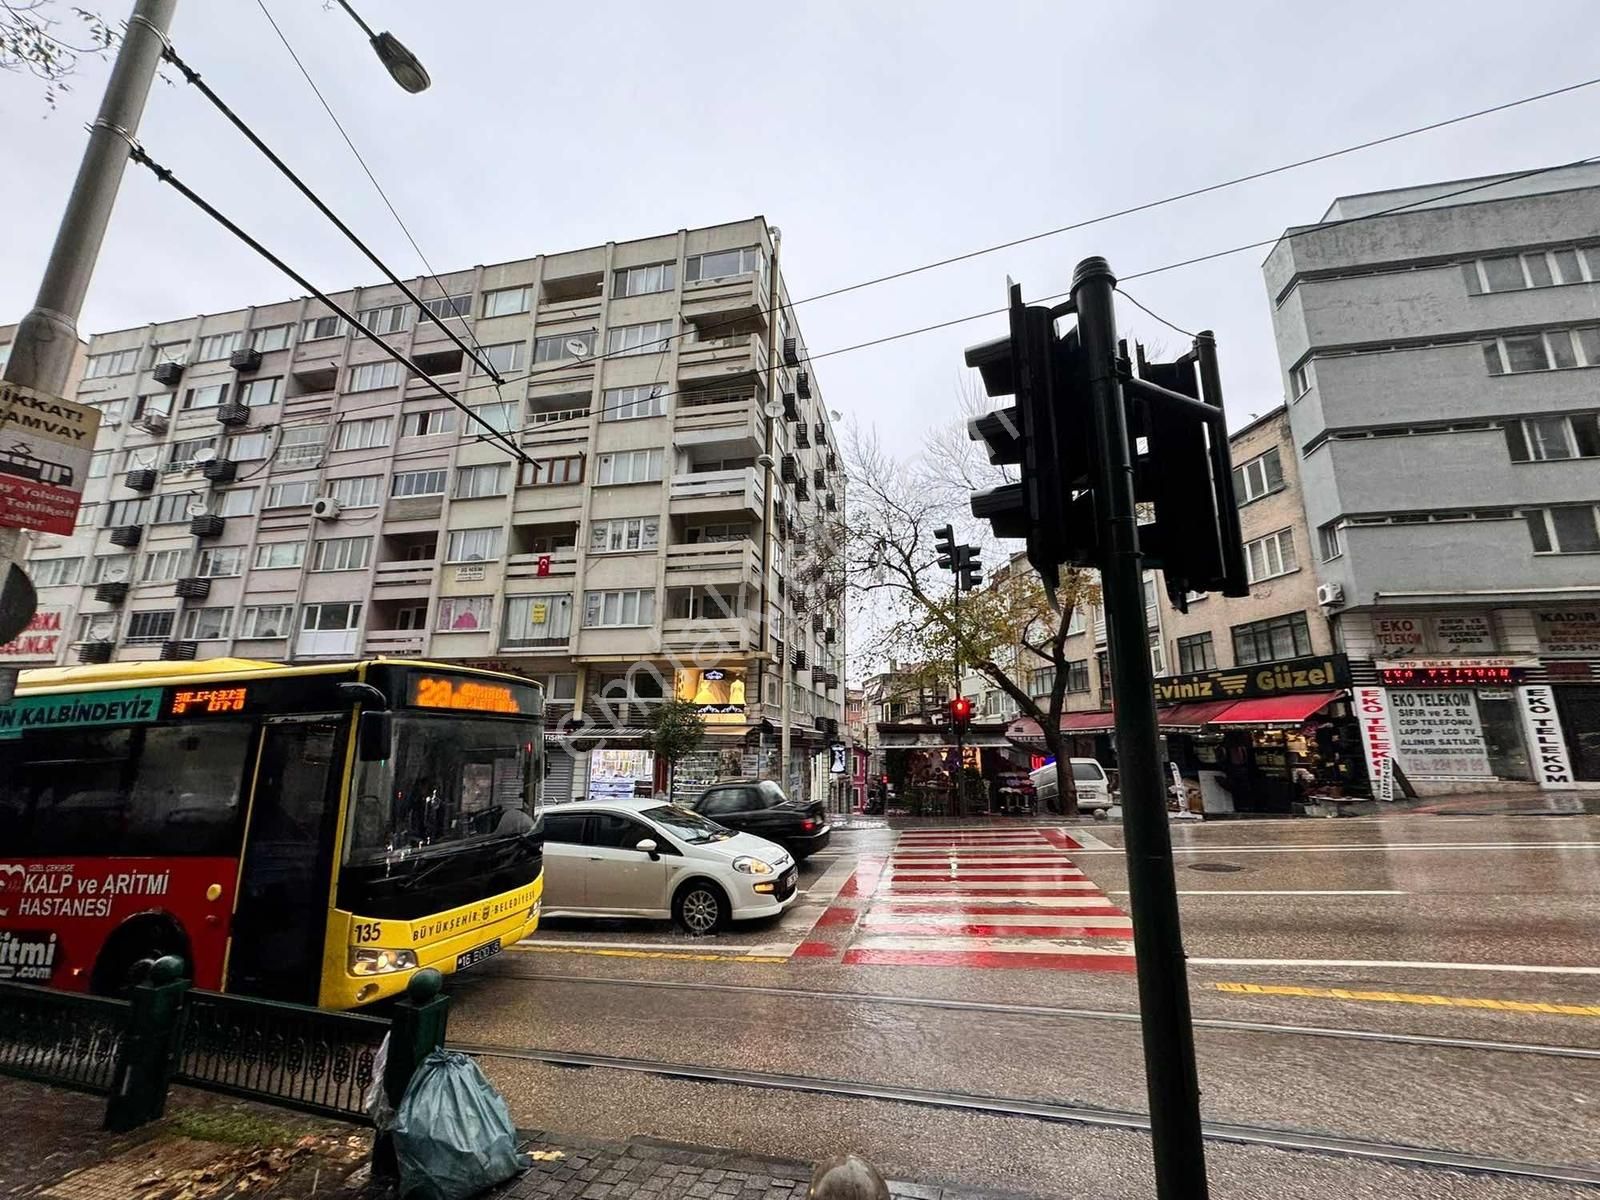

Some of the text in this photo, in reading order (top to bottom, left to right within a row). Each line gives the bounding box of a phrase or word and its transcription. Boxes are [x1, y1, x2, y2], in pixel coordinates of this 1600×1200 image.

[0, 388, 83, 423] İKKAT!
[1380, 620, 1413, 632] EKO
[1376, 633, 1423, 646] TELEKOM
[1256, 662, 1336, 691] Güzel
[19, 694, 154, 726] KALBİNDEYİZ
[1361, 689, 1384, 713] EKO
[1391, 694, 1415, 707] EKO
[1416, 693, 1471, 707] TELEKOM
[1526, 688, 1552, 714] EKO
[1398, 709, 1426, 717] SIFIR
[1456, 708, 1470, 717] EL
[1531, 718, 1570, 783] TELEKOM
[23, 869, 171, 895] KALP ve ARİTMİ
[19, 895, 113, 917] HASTANESİ
[493, 890, 536, 914] BELEDİYESİ
[354, 922, 382, 944] 135
[412, 910, 478, 941] BÜYÜKŞEHİR
